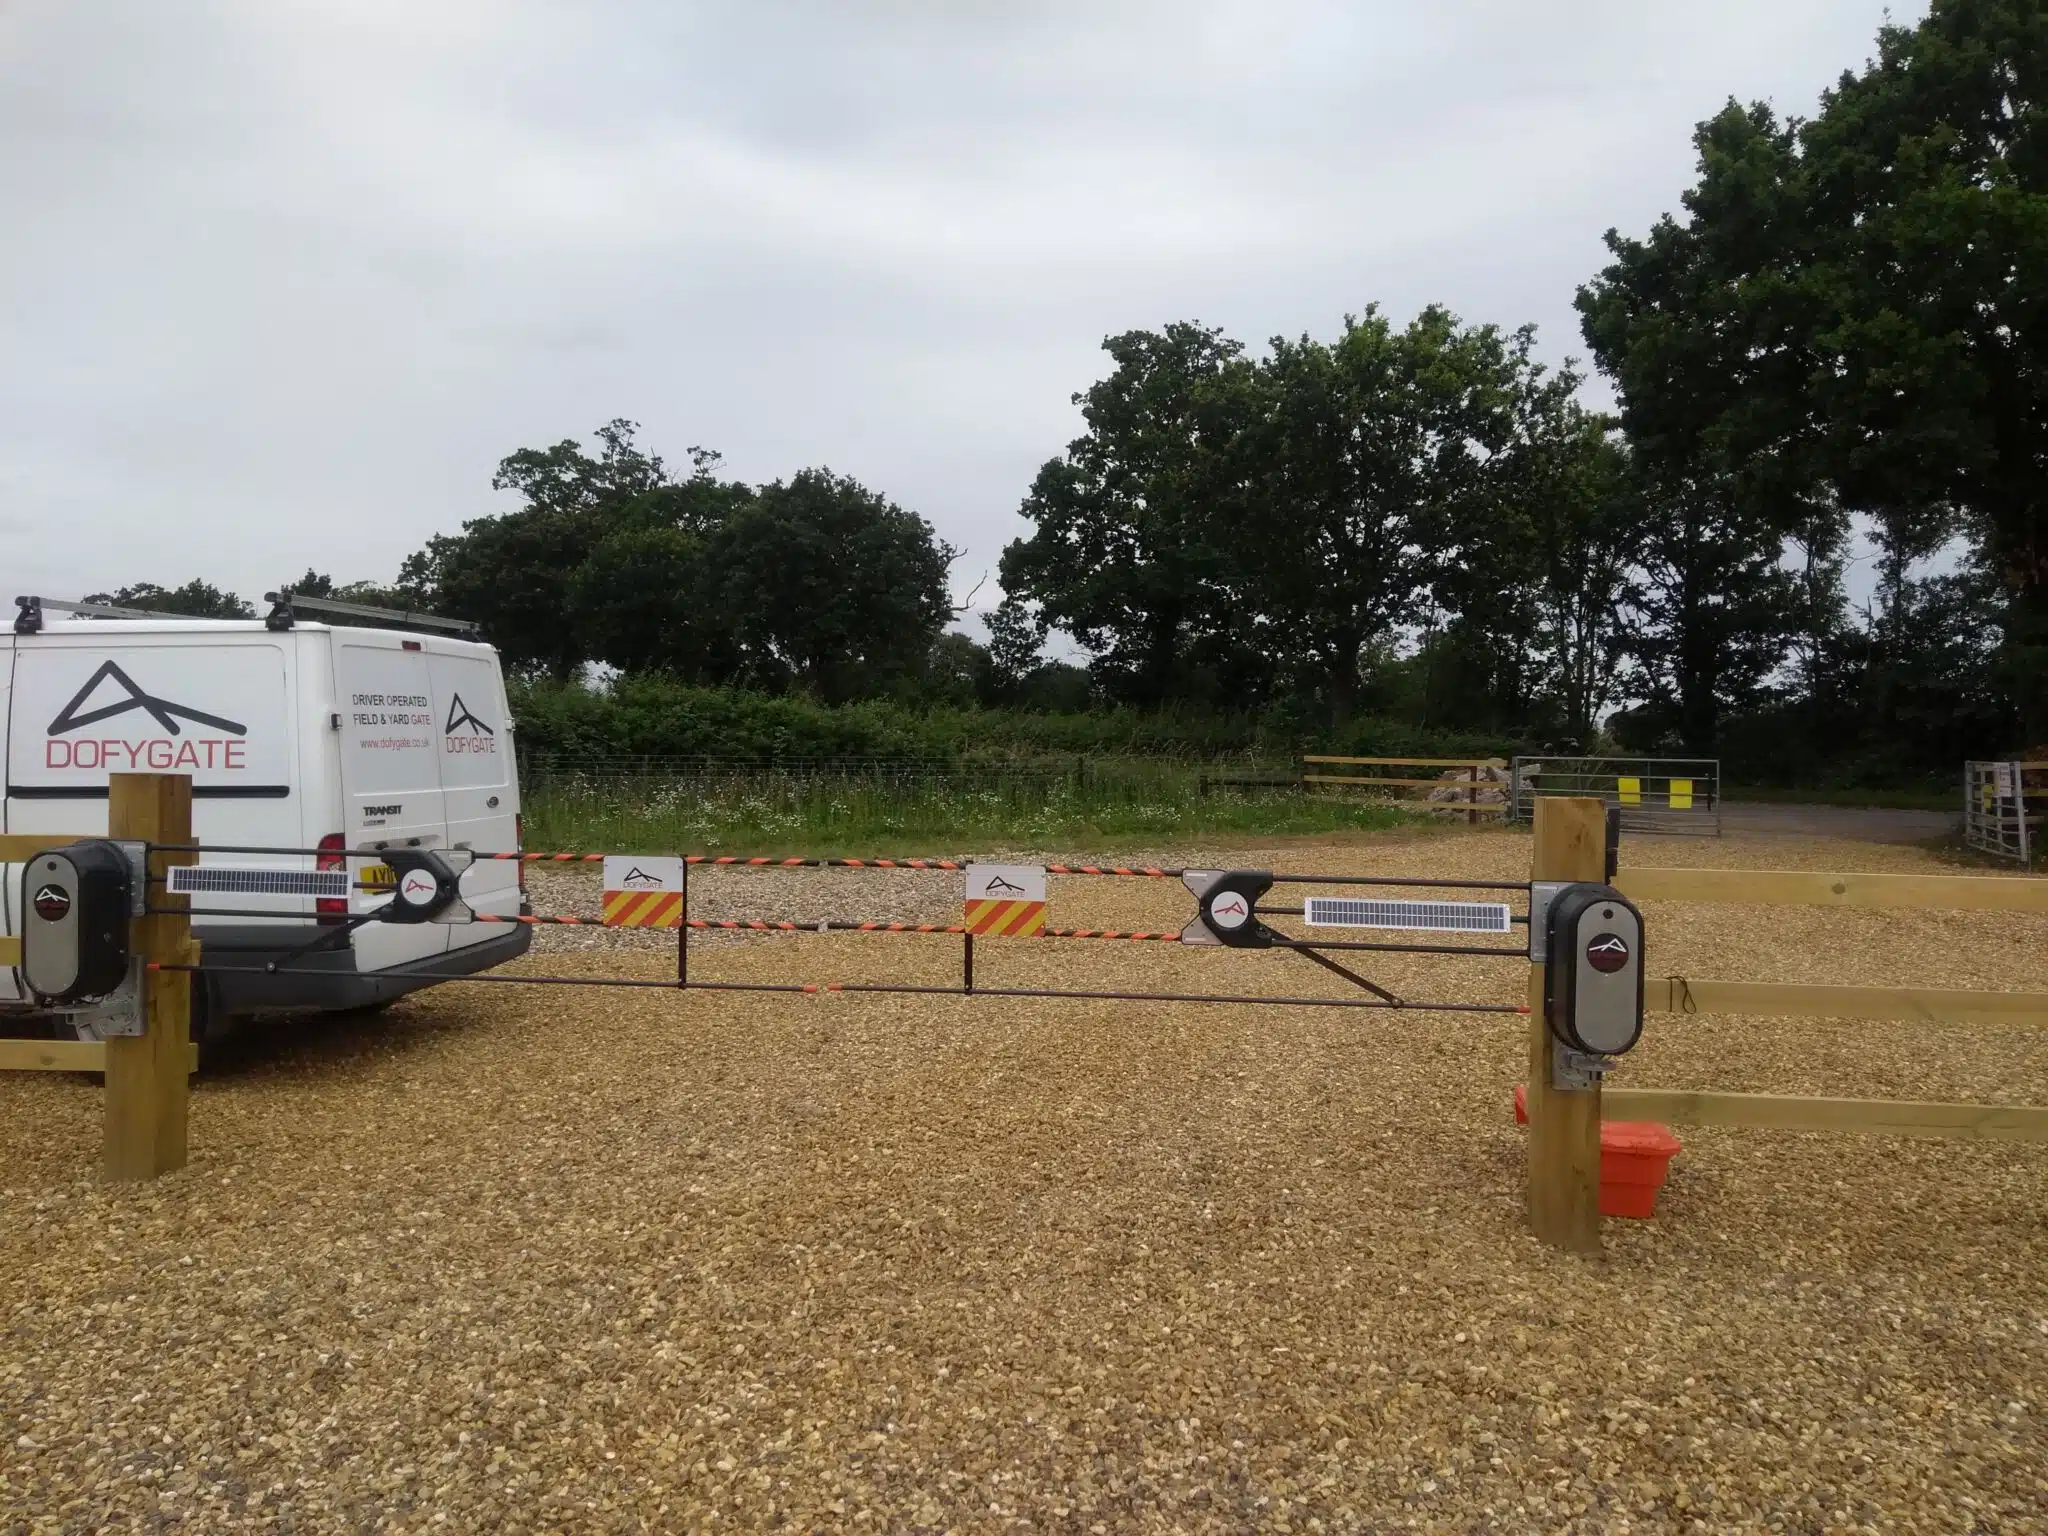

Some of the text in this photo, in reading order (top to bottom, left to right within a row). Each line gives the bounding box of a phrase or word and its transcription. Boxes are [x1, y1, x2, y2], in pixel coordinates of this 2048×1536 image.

[352, 694, 428, 707] DRIVER OPERATED
[353, 714, 431, 725] FIELD & YARD GATE
[360, 737, 429, 751] www.dofygate.co.uk
[446, 737, 496, 753] DOFYGATE
[46, 740, 246, 769] DOFYGATE
[363, 805, 402, 816] TRANSIT
